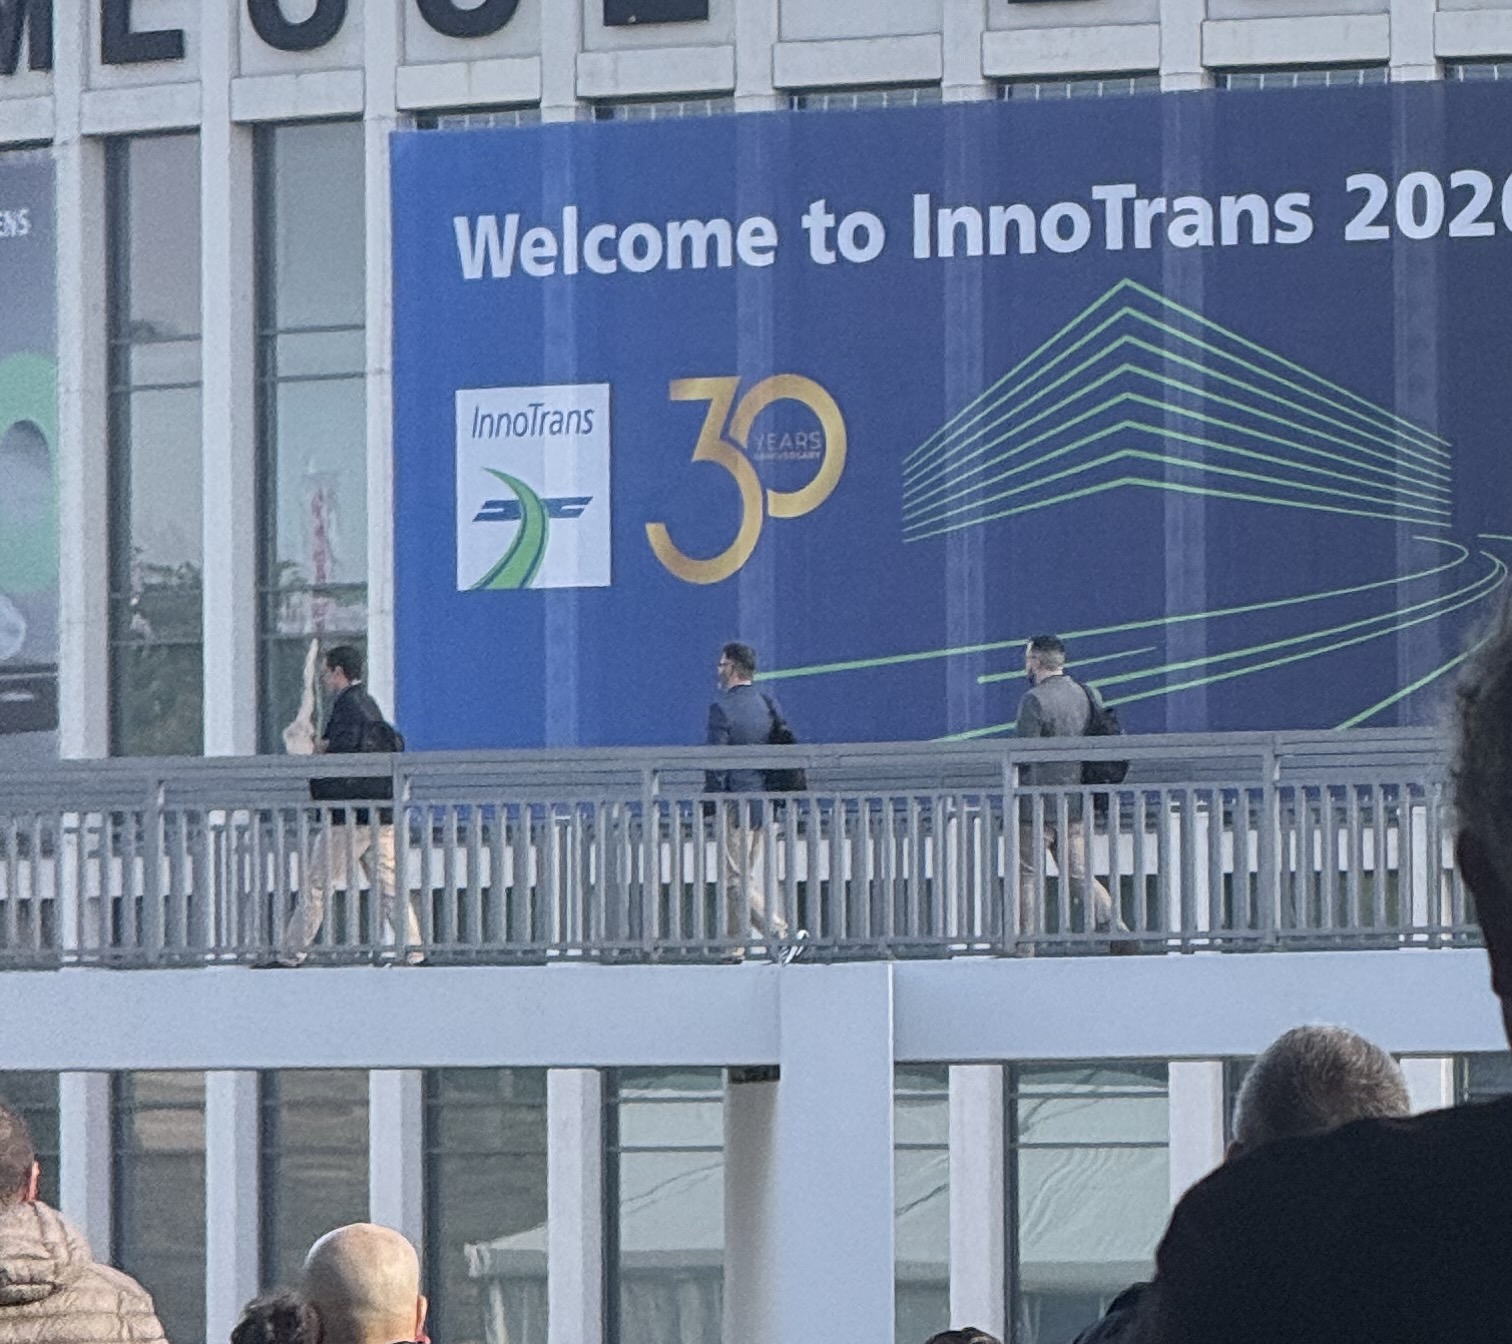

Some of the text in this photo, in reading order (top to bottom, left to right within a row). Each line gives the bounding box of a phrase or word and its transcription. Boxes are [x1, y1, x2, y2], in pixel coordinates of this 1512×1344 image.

[0, 207, 32, 238] NS
[453, 205, 778, 280] Welcome
[801, 199, 885, 265] to
[913, 183, 1314, 259] InnoTrans
[471, 402, 595, 440] InnoTrans
[753, 430, 822, 452] YEARS
[645, 372, 848, 586] 30
